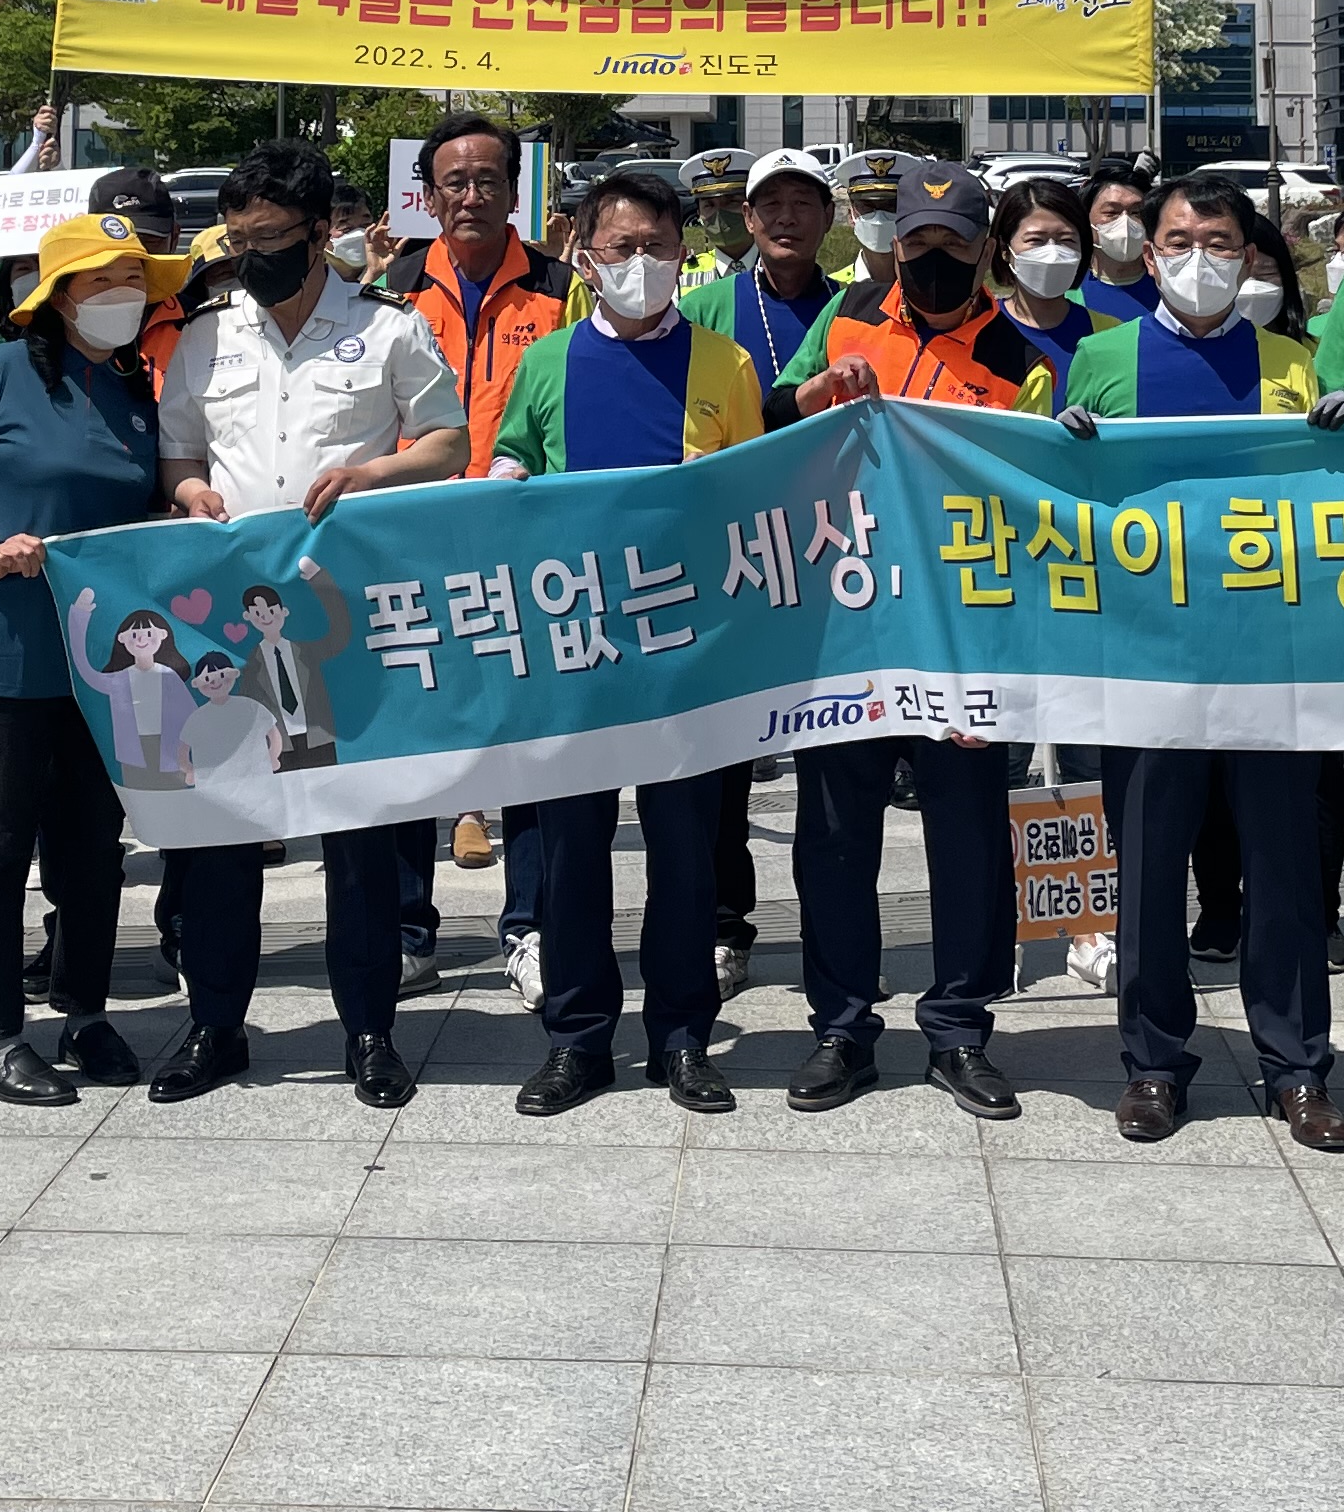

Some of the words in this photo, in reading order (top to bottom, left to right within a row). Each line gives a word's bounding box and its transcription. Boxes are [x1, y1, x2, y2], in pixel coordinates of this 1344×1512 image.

[354, 44, 432, 69] 2022.
[443, 49, 467, 70] 5.
[477, 51, 501, 72] 4.
[594, 52, 678, 76] Jindo
[700, 54, 778, 76] 진도군
[364, 545, 699, 691] 폭력없는
[721, 488, 903, 612] 세상,
[939, 493, 1189, 614] 관심이
[759, 688, 866, 742] Jindo
[1027, 876, 1082, 920] 우리가
